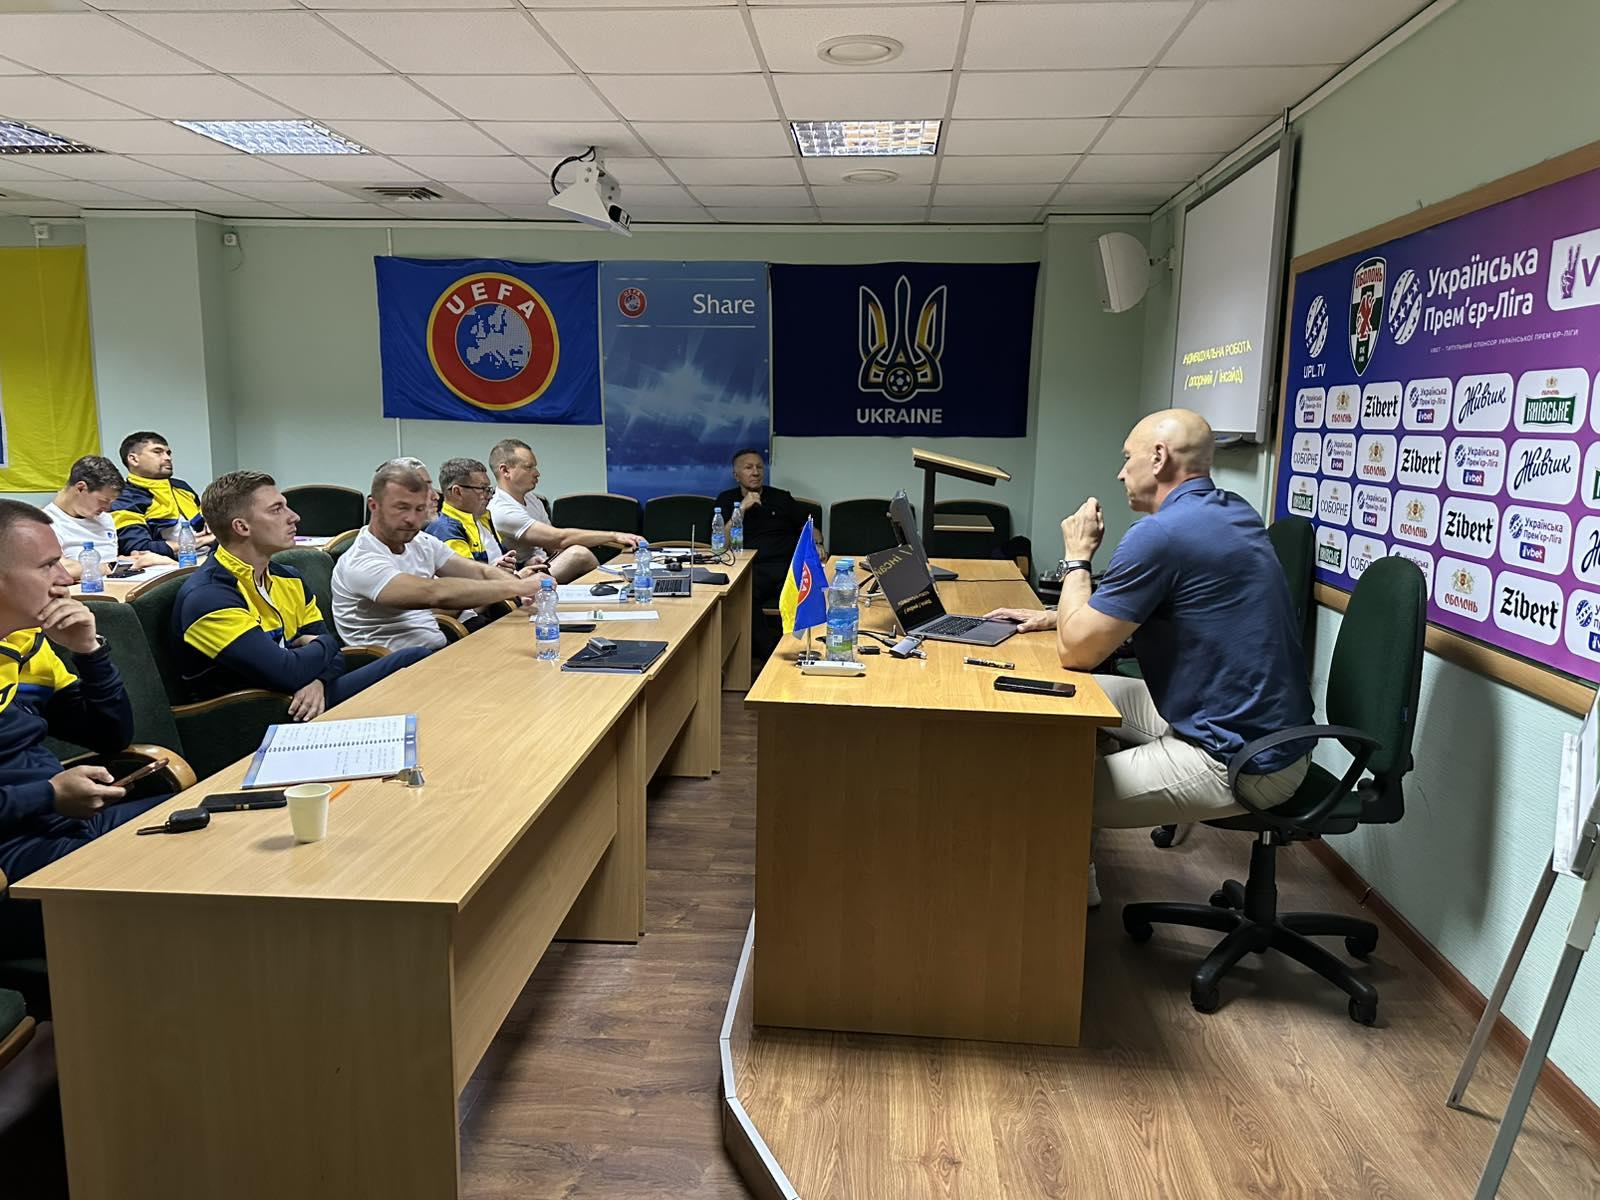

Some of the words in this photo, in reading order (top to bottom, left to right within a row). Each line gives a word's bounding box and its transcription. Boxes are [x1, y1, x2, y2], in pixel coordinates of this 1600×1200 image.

[1355, 267, 1383, 289] ОБОЛОНЬ
[1426, 247, 1538, 300] Українська
[445, 281, 536, 320] UEFA
[692, 293, 755, 316] Share
[1225, 340, 1252, 355] РОБОТА
[1303, 363, 1326, 379] UPL.TV
[1420, 386, 1447, 397] Українська
[1363, 395, 1398, 418] Zibert
[1458, 382, 1506, 424] Живчик
[1526, 399, 1571, 422] КИЇВСЬКЕ
[856, 408, 942, 425] UKRAINE
[1401, 448, 1442, 475] Zibert
[1468, 446, 1500, 458] Українська
[1362, 464, 1386, 477] ОБОЛОНЬ
[1514, 446, 1572, 490] Живчик
[1320, 500, 1348, 517] СОБОРНЕ
[1400, 524, 1428, 538] ОБОЛОНЬ
[1445, 510, 1494, 544] Zibert
[1524, 518, 1564, 533] Українська
[1526, 548, 1543, 559] vbet
[1444, 593, 1478, 614] ОБОЛОНЬ
[1500, 586, 1559, 630] Zibert
